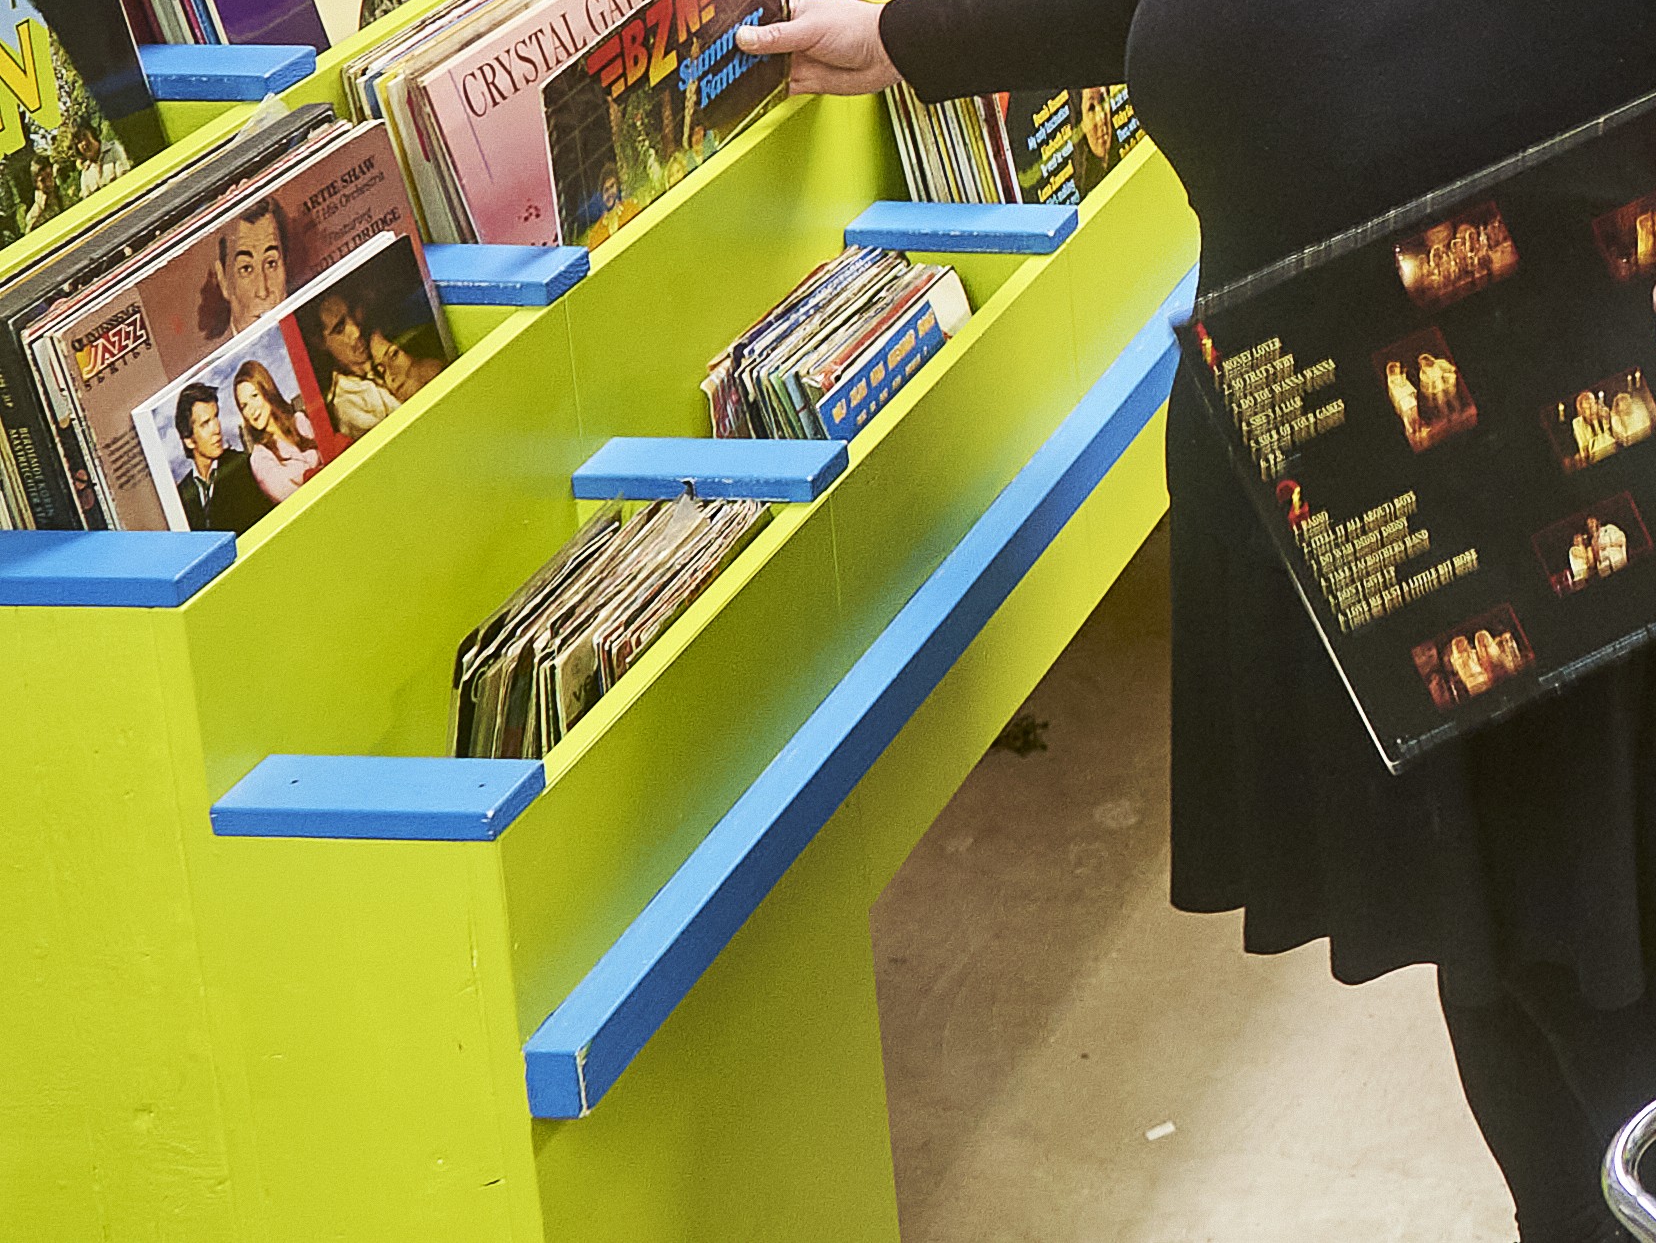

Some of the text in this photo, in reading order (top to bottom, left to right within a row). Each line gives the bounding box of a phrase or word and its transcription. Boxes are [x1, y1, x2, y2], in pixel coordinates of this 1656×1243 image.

[462, 21, 589, 118] CRYSTAL
[301, 155, 377, 213] ARTIE SHAW
[76, 313, 147, 380] JAZZ
